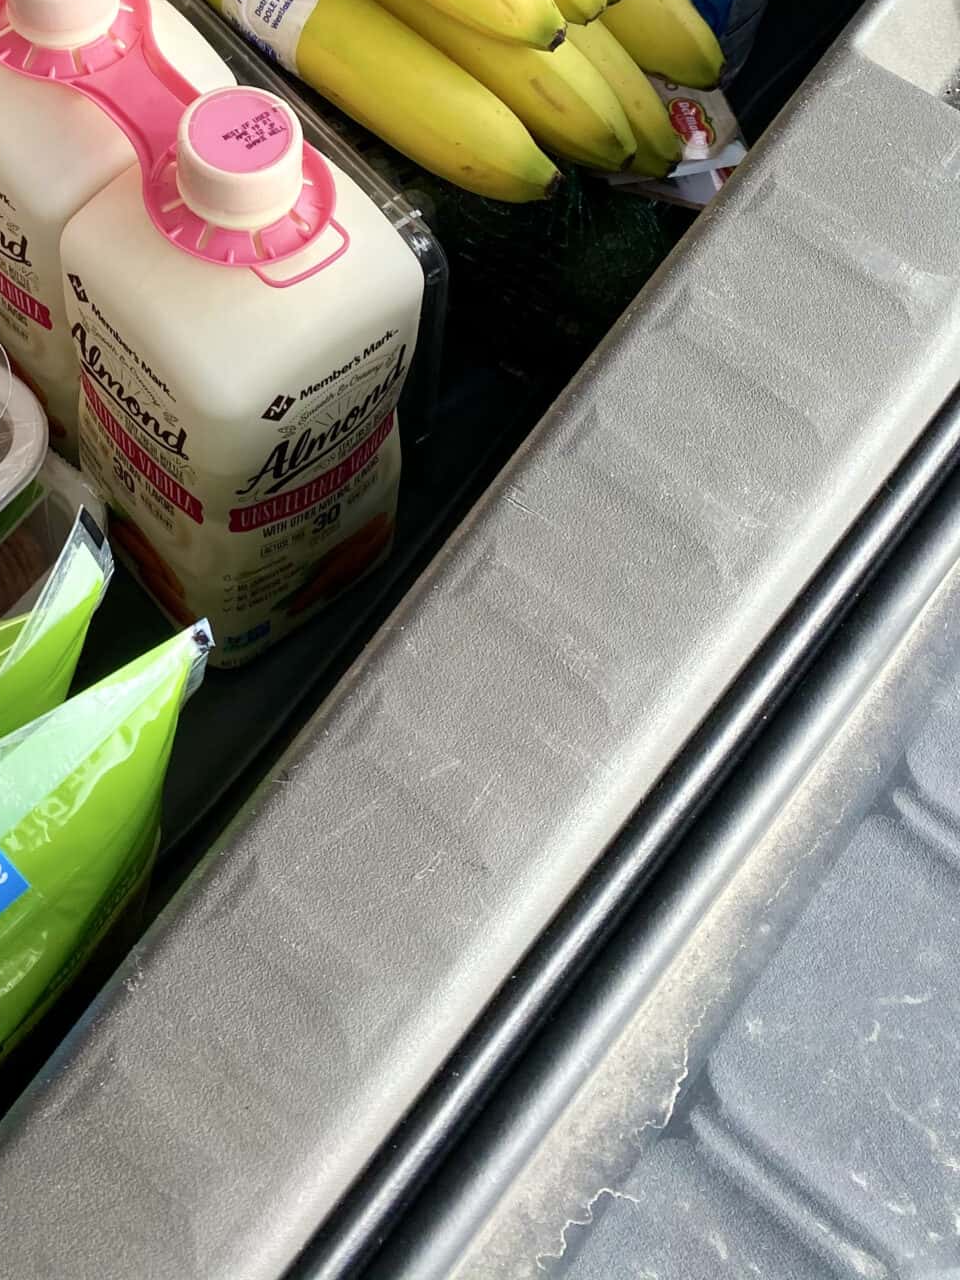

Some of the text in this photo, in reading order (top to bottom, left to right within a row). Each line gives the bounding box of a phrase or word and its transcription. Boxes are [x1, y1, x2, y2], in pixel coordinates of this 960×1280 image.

[262, 1, 278, 24] DOLE
[222, 129, 240, 140] BEST
[91, 302, 140, 363] Member's
[141, 358, 170, 394] Mark
[299, 330, 393, 401] Member's Mark
[72, 322, 188, 456] Almond
[235, 344, 407, 495] Almond
[312, 504, 340, 535] 30
